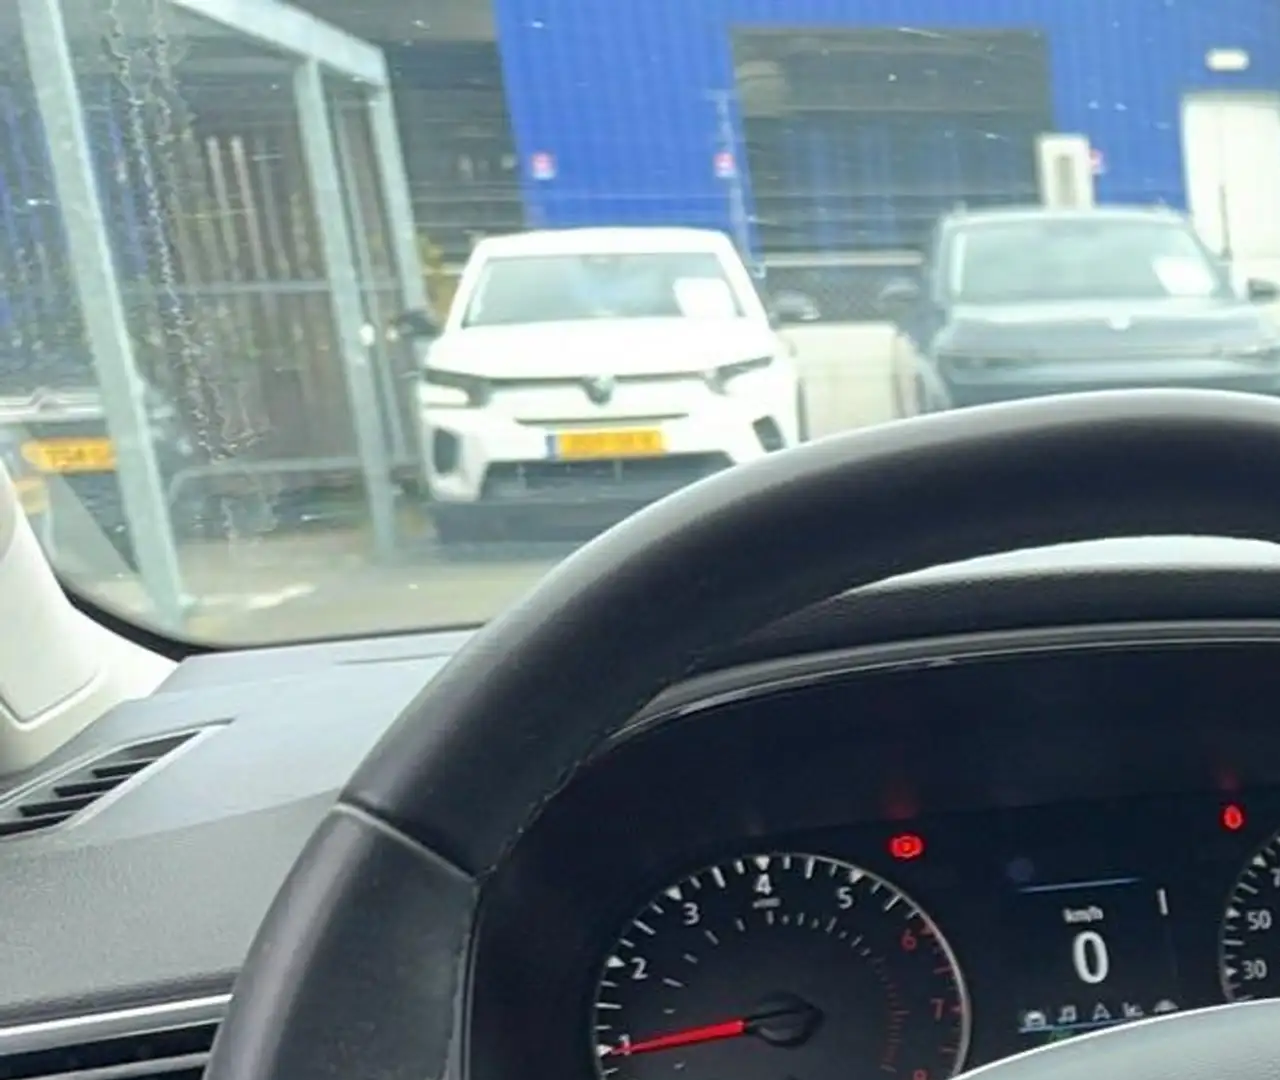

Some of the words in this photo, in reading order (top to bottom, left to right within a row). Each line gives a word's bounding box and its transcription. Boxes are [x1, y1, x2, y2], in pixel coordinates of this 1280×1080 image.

[754, 873, 772, 895] 4
[837, 886, 854, 910] 5
[682, 902, 700, 926] 3
[1247, 909, 1273, 932] 50
[901, 928, 918, 951] 6
[630, 957, 649, 980] 2
[1072, 930, 1110, 984] 0
[1241, 959, 1267, 981] 30
[930, 998, 945, 1021] 7
